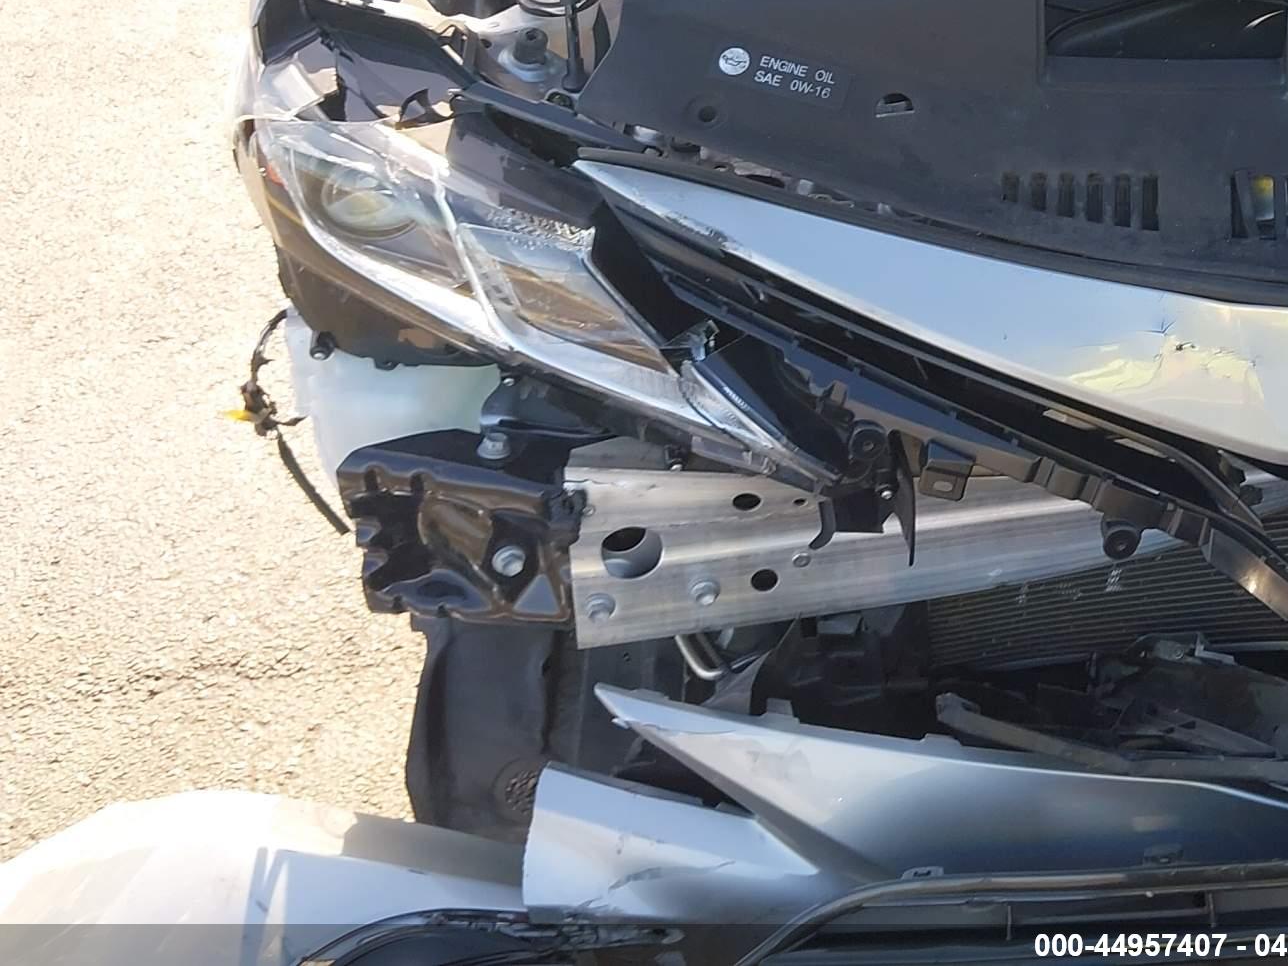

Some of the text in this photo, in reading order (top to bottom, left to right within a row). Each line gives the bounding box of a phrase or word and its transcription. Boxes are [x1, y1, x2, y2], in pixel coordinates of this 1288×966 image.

[760, 55, 835, 84] ENGINE OIL
[754, 70, 831, 99] SAE 0W-16
